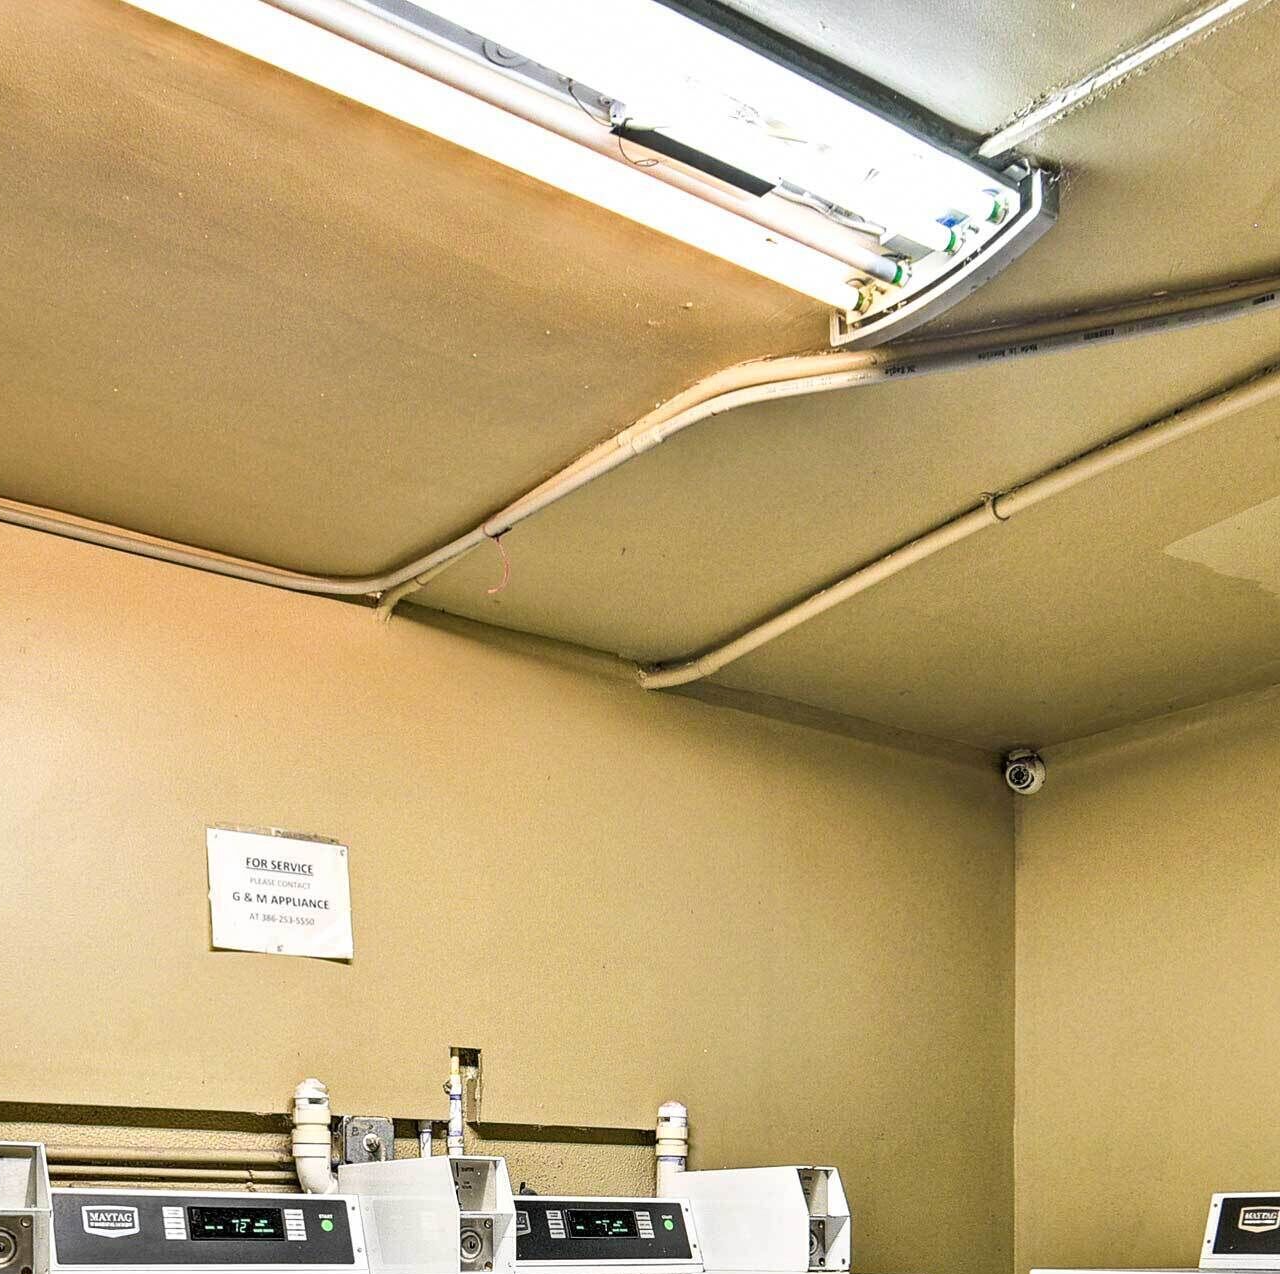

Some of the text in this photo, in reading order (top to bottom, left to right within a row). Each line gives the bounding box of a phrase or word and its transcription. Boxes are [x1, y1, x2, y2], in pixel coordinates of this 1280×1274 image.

[246, 857, 314, 875] FOR SERVICE
[249, 877, 311, 890] PLEASE CONTACT
[232, 891, 329, 910] G & M APPLIANCE
[249, 913, 259, 921] AT
[89, 1212, 133, 1222] MAYTAG
